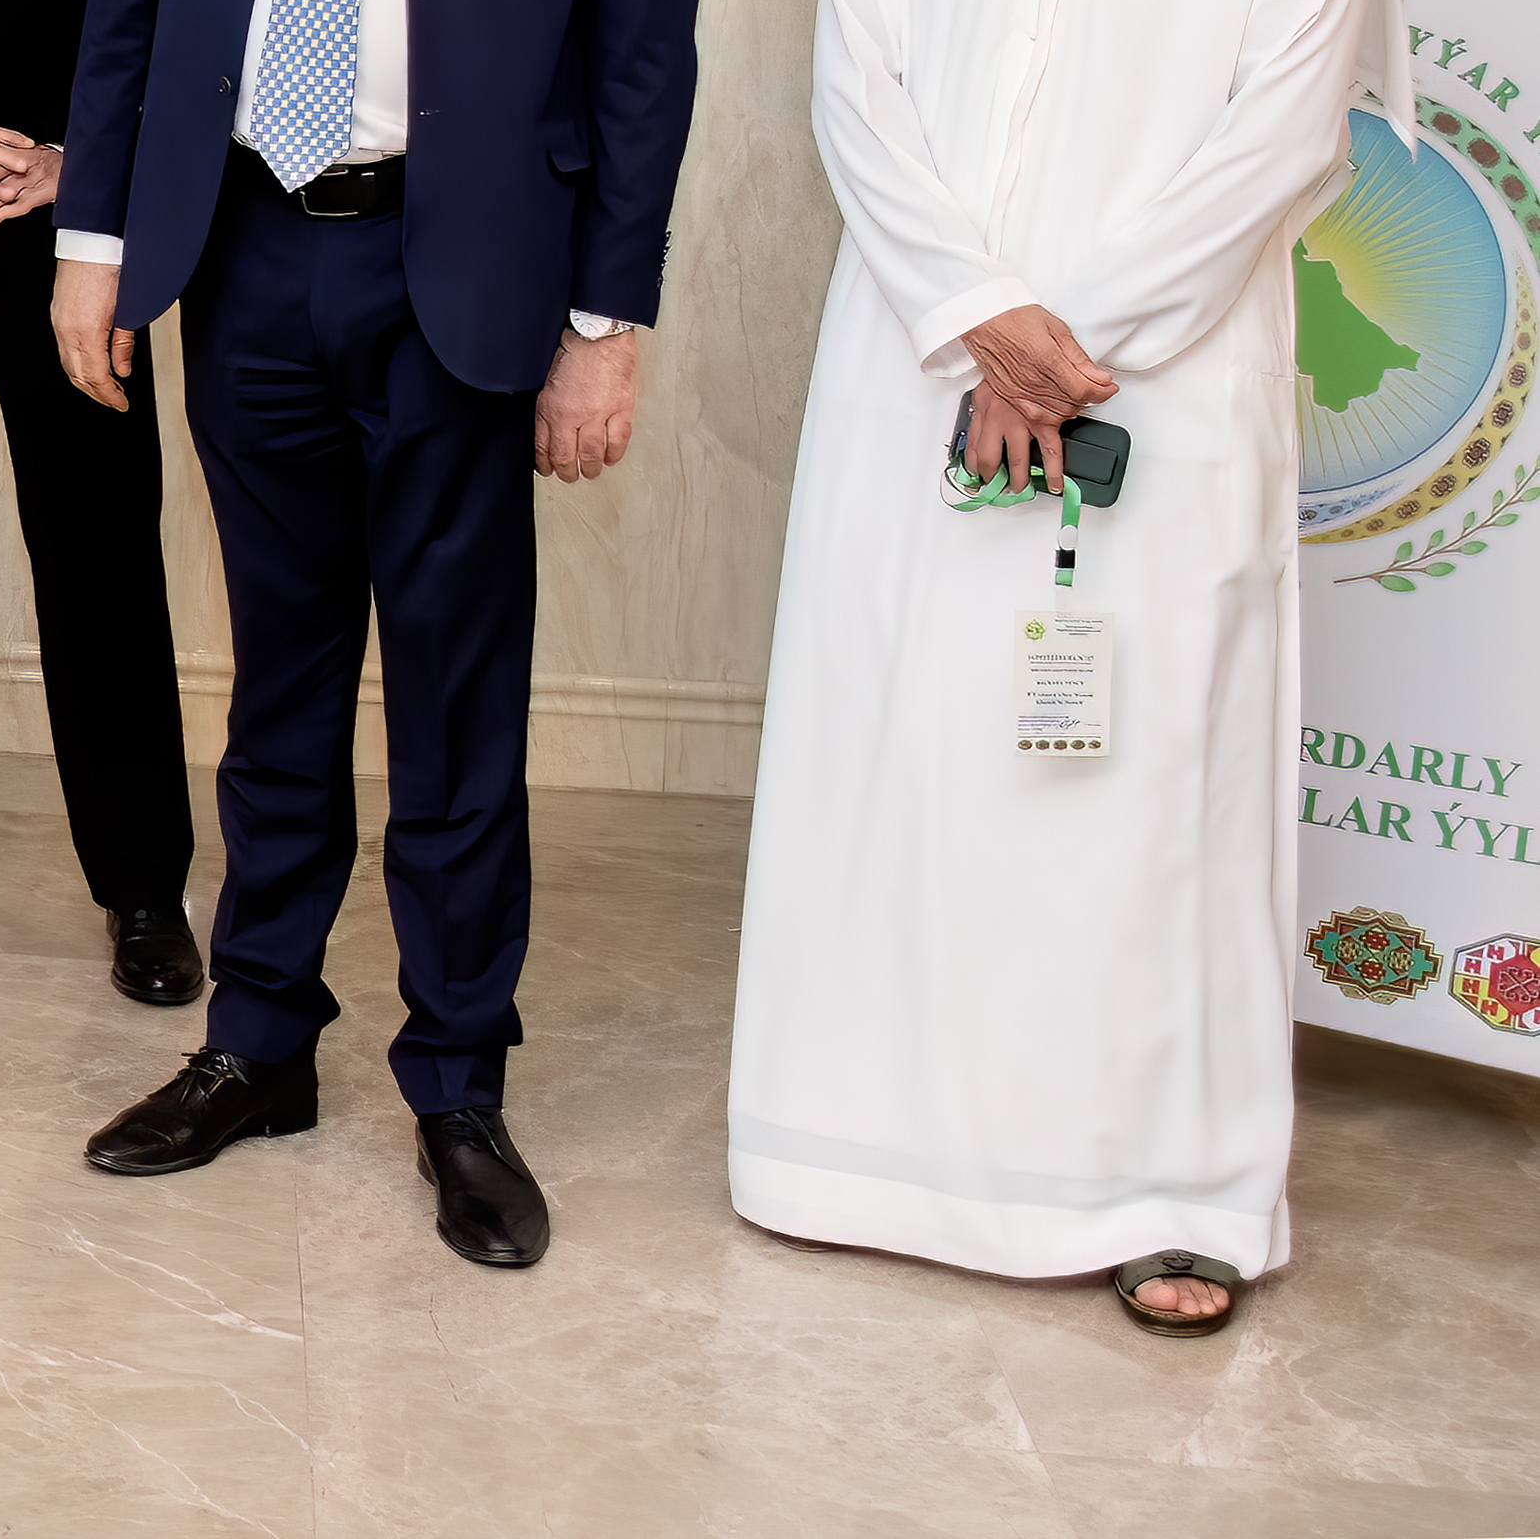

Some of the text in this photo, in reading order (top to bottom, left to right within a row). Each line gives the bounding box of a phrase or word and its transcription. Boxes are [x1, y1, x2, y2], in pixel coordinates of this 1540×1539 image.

[1408, 24, 1520, 113] YÝAR
[1300, 725, 1522, 798] RDARLY
[1298, 786, 1540, 866] LAR ÝYL
